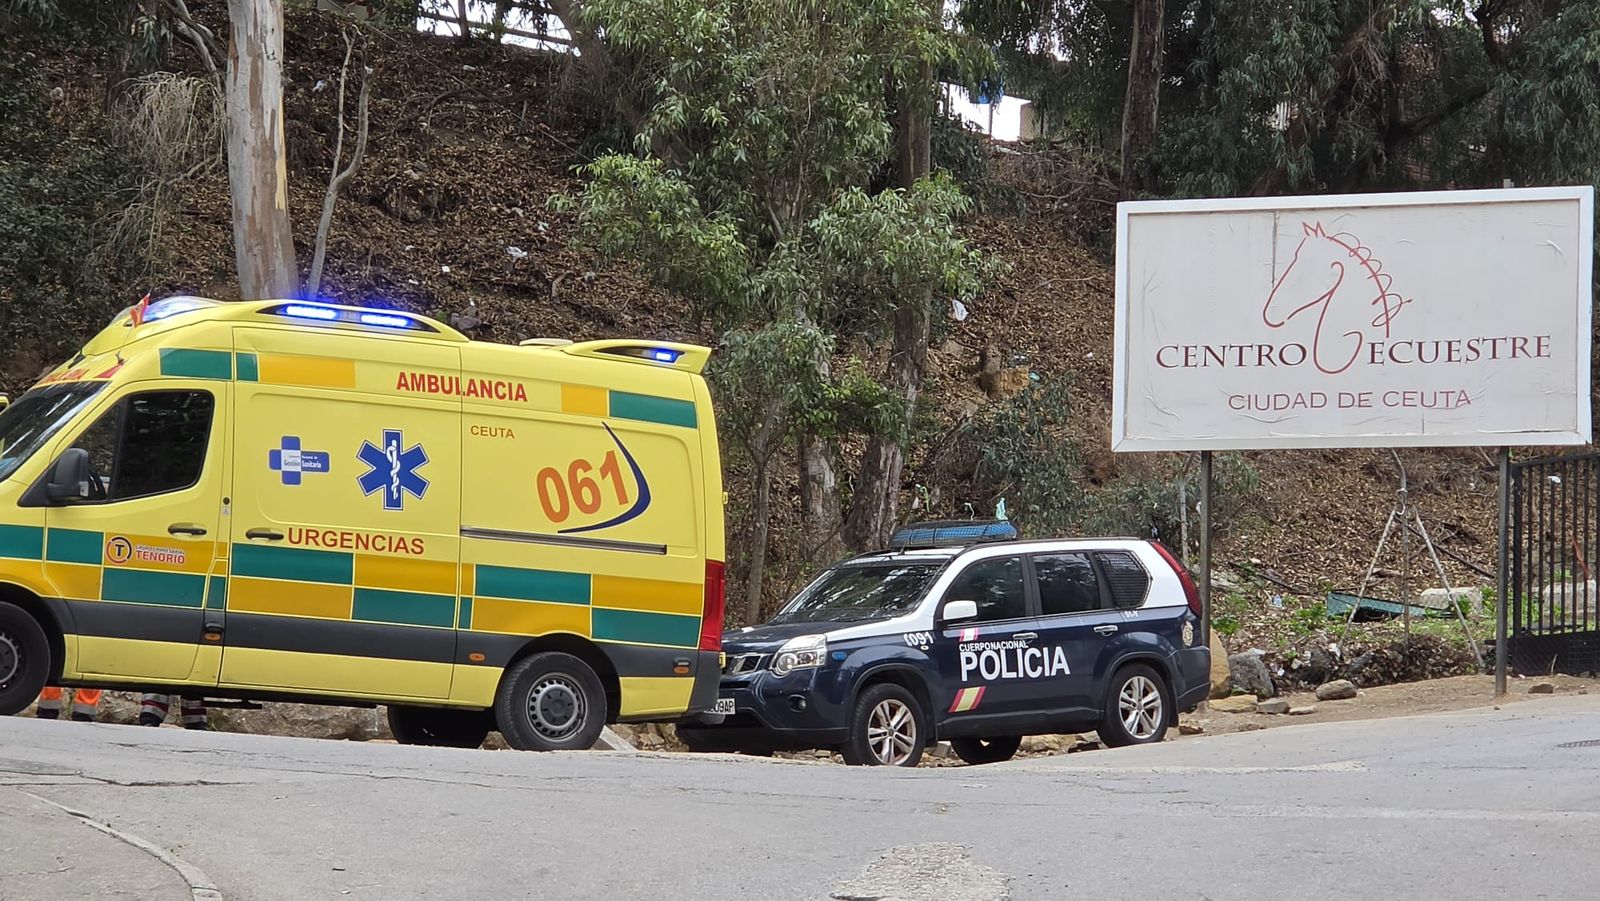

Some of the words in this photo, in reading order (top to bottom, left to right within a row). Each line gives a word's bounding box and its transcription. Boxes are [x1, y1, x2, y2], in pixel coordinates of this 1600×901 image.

[1156, 343, 1307, 368] CENTRO
[1367, 335, 1551, 365] ECUESTRE
[396, 372, 528, 401] AMBULANCIA
[1228, 392, 1328, 411] CIUDAD
[1338, 392, 1373, 408] DE
[1382, 390, 1472, 408] CEUTA
[470, 425, 515, 439] CEUTA
[536, 450, 629, 523] 061
[288, 527, 425, 555] URGENCIAS
[136, 550, 185, 564] TENORIO
[960, 646, 1071, 681] POLICIA
